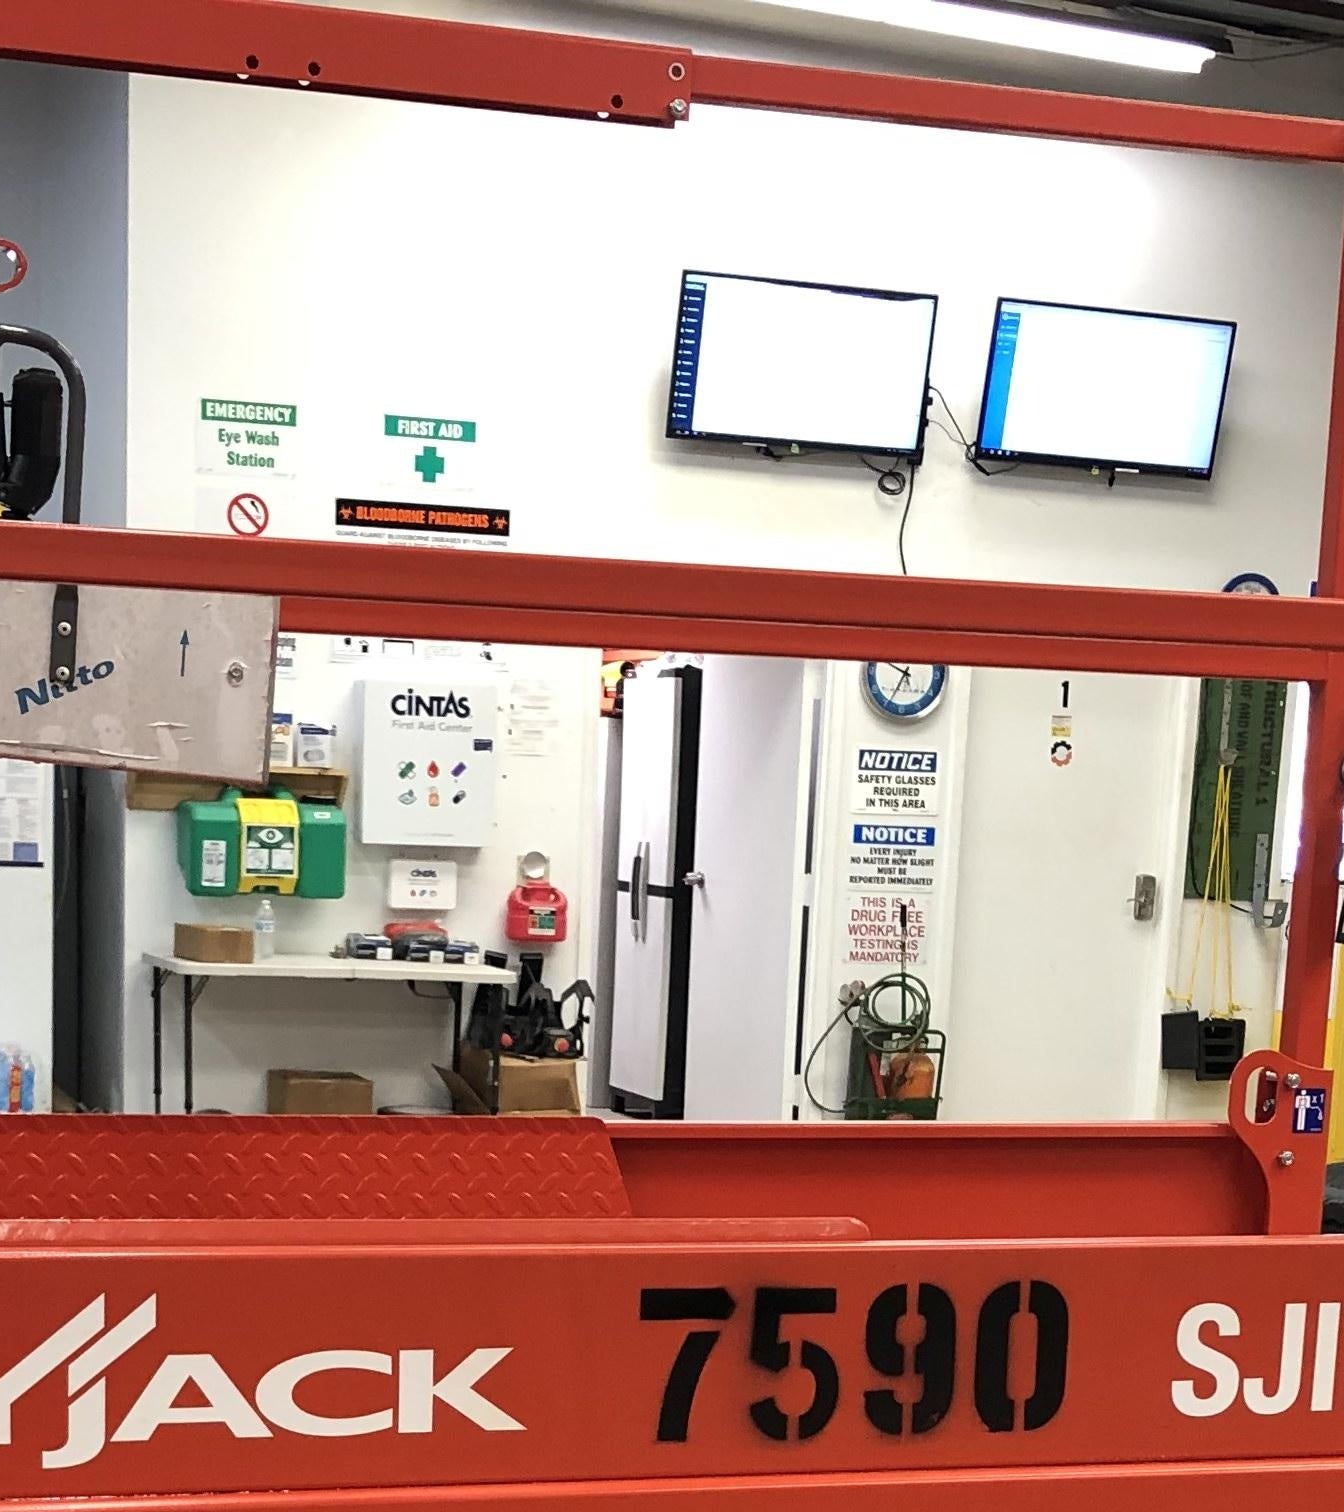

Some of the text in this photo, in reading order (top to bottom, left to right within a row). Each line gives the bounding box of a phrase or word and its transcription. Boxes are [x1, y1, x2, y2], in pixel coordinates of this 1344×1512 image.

[206, 401, 294, 423] EMERGENCY
[398, 420, 464, 438] FIRST AID
[218, 428, 280, 447] Eye Wash
[227, 451, 275, 468] Station
[356, 506, 490, 528] BLOODBORNE PATHOGENS
[1062, 681, 1069, 708] 1
[391, 688, 471, 718] CINTAS
[392, 720, 473, 734] First Aid Center
[860, 751, 935, 771] NOTICE
[858, 774, 936, 786] SAFETY GLASSES
[873, 786, 920, 797] REQUIRED
[866, 798, 926, 809] IN THIS AREA
[861, 826, 928, 844] NOTICE
[869, 847, 917, 857] EVERY INJURY
[850, 856, 935, 867] NO MATTER HOW SLIGHT
[877, 867, 907, 876] MUST BE
[849, 875, 934, 886] REPORTED IMMEDIATELY
[860, 896, 915, 908] THIS IS A
[851, 909, 924, 923] DRUG FEE
[853, 939, 919, 951] TESTING IS
[849, 951, 920, 963] MANDATORY
[639, 1280, 1070, 1443] 7590
